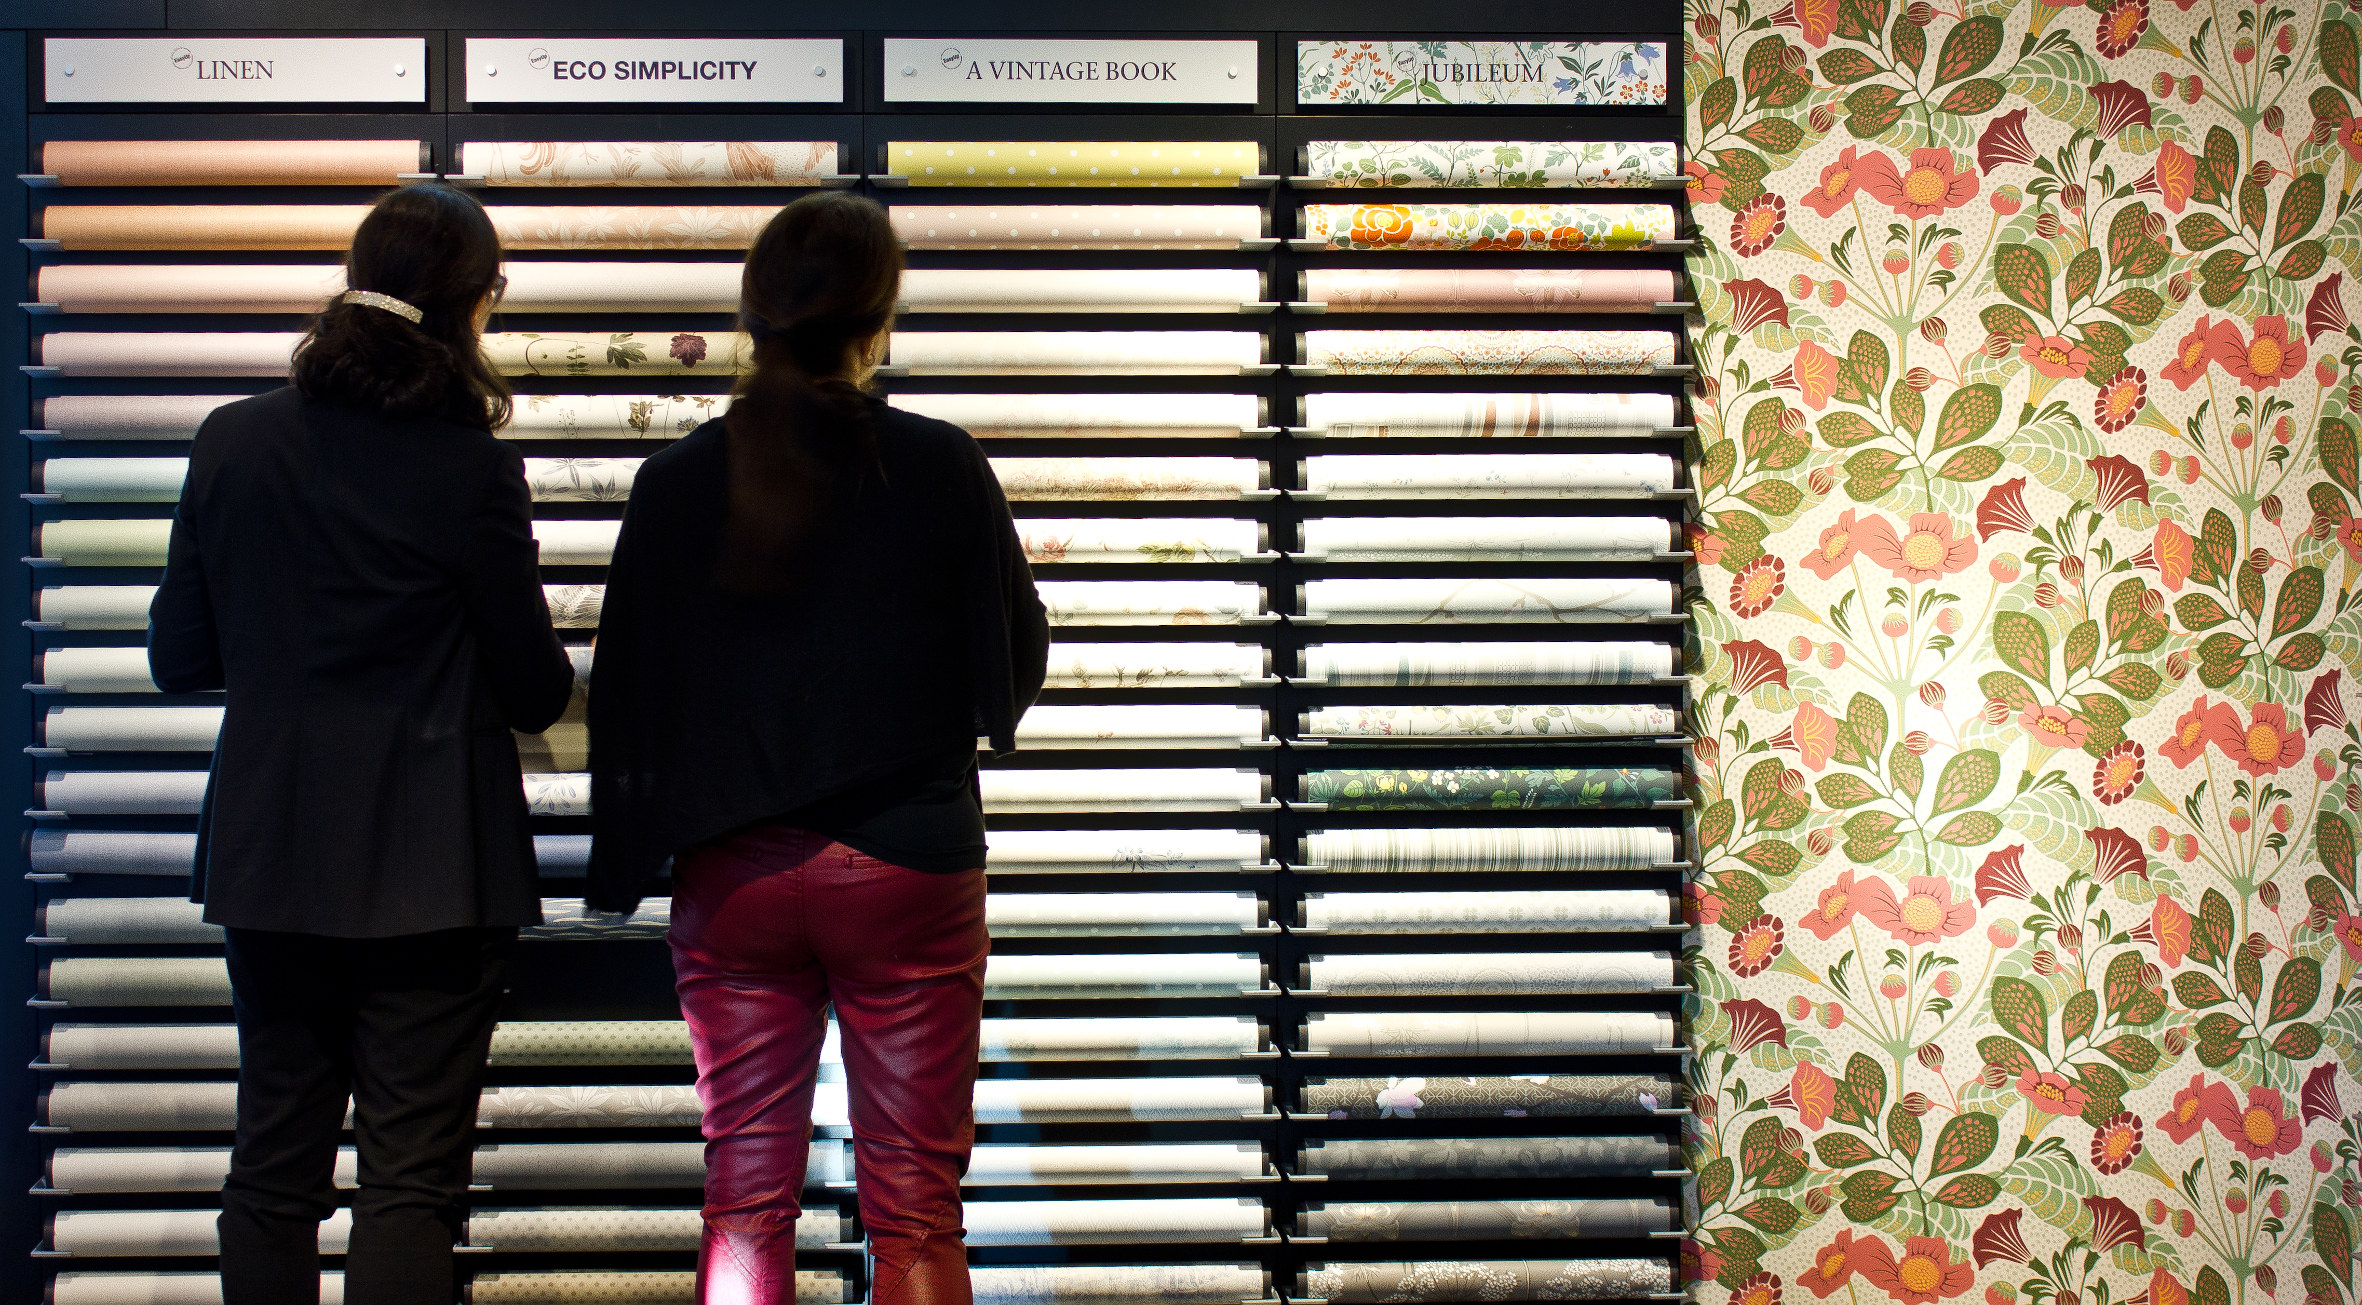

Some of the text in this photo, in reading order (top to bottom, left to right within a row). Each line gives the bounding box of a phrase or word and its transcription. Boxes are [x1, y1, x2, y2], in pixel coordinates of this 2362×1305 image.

[530, 54, 548, 64] EasyUp
[942, 54, 960, 64] EasyUp
[197, 60, 274, 79] LINEN
[553, 60, 757, 80] ECO SIMPLICITY
[966, 60, 1177, 81] A VINTAGE BOOK
[1420, 63, 1543, 86] JUBILEUM
